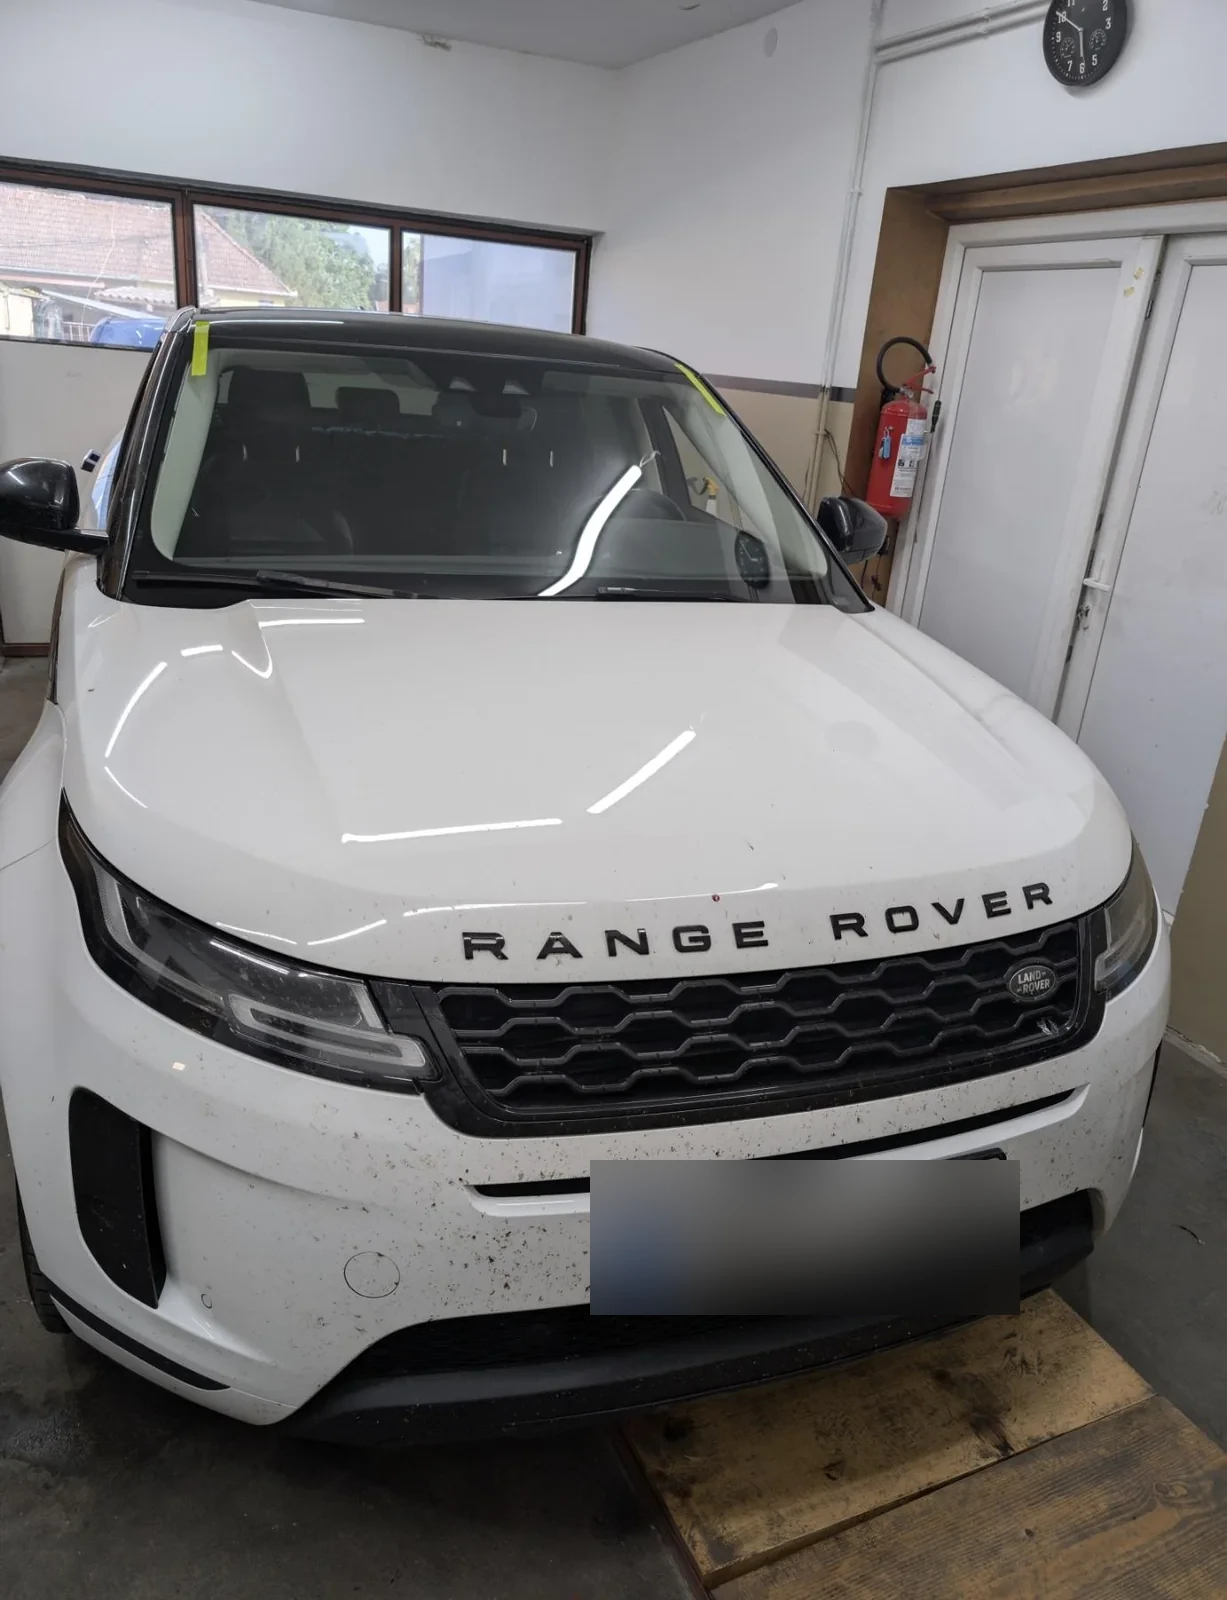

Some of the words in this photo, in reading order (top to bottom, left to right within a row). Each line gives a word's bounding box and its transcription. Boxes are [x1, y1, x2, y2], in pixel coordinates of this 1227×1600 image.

[1102, 0, 1109, 11] 2
[1057, 11, 1067, 24] 10
[1105, 17, 1112, 30] 3
[1056, 31, 1062, 43] 9
[1067, 60, 1073, 72] 7
[1092, 54, 1098, 66] 5
[1079, 62, 1085, 74] 6
[462, 921, 769, 961] RANGE
[829, 882, 1053, 941] ROVER
[1018, 970, 1041, 984] LAND
[1022, 979, 1050, 995] ROVER
